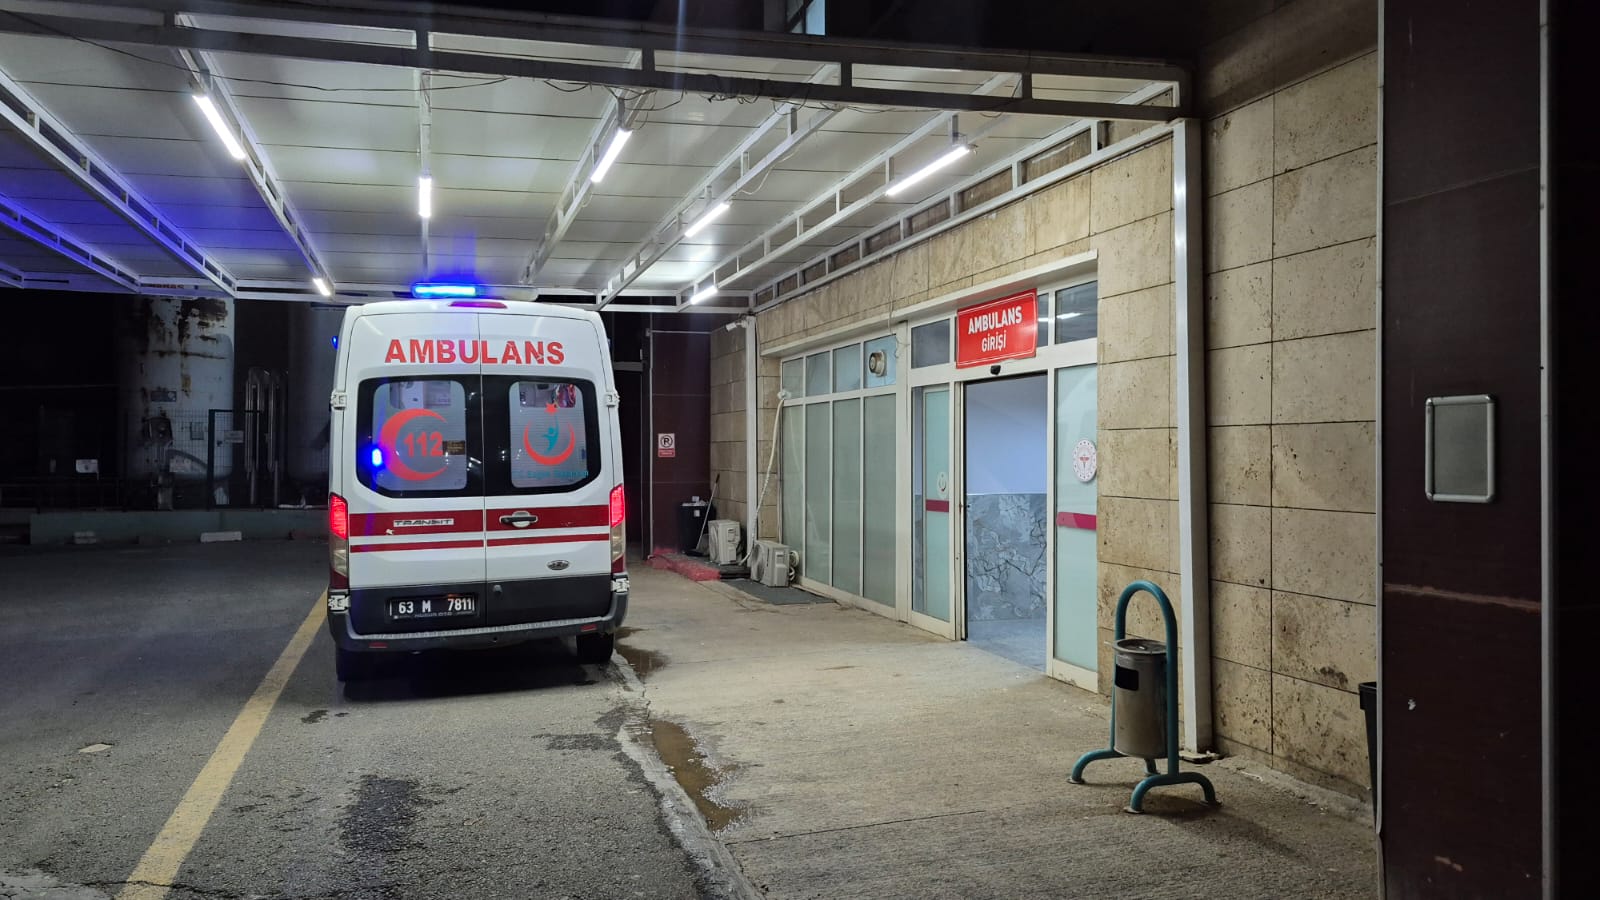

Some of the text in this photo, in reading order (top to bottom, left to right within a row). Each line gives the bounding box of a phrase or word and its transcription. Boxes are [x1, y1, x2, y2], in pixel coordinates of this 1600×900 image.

[968, 306, 1022, 335] AMBULANS
[384, 339, 565, 365] AMBULANS
[982, 330, 1006, 352] GİRİŞİ
[403, 431, 443, 457] 112
[394, 519, 453, 527] TRANSIT
[398, 601, 414, 614] 63
[421, 600, 431, 613] M
[447, 598, 472, 611] 7811
